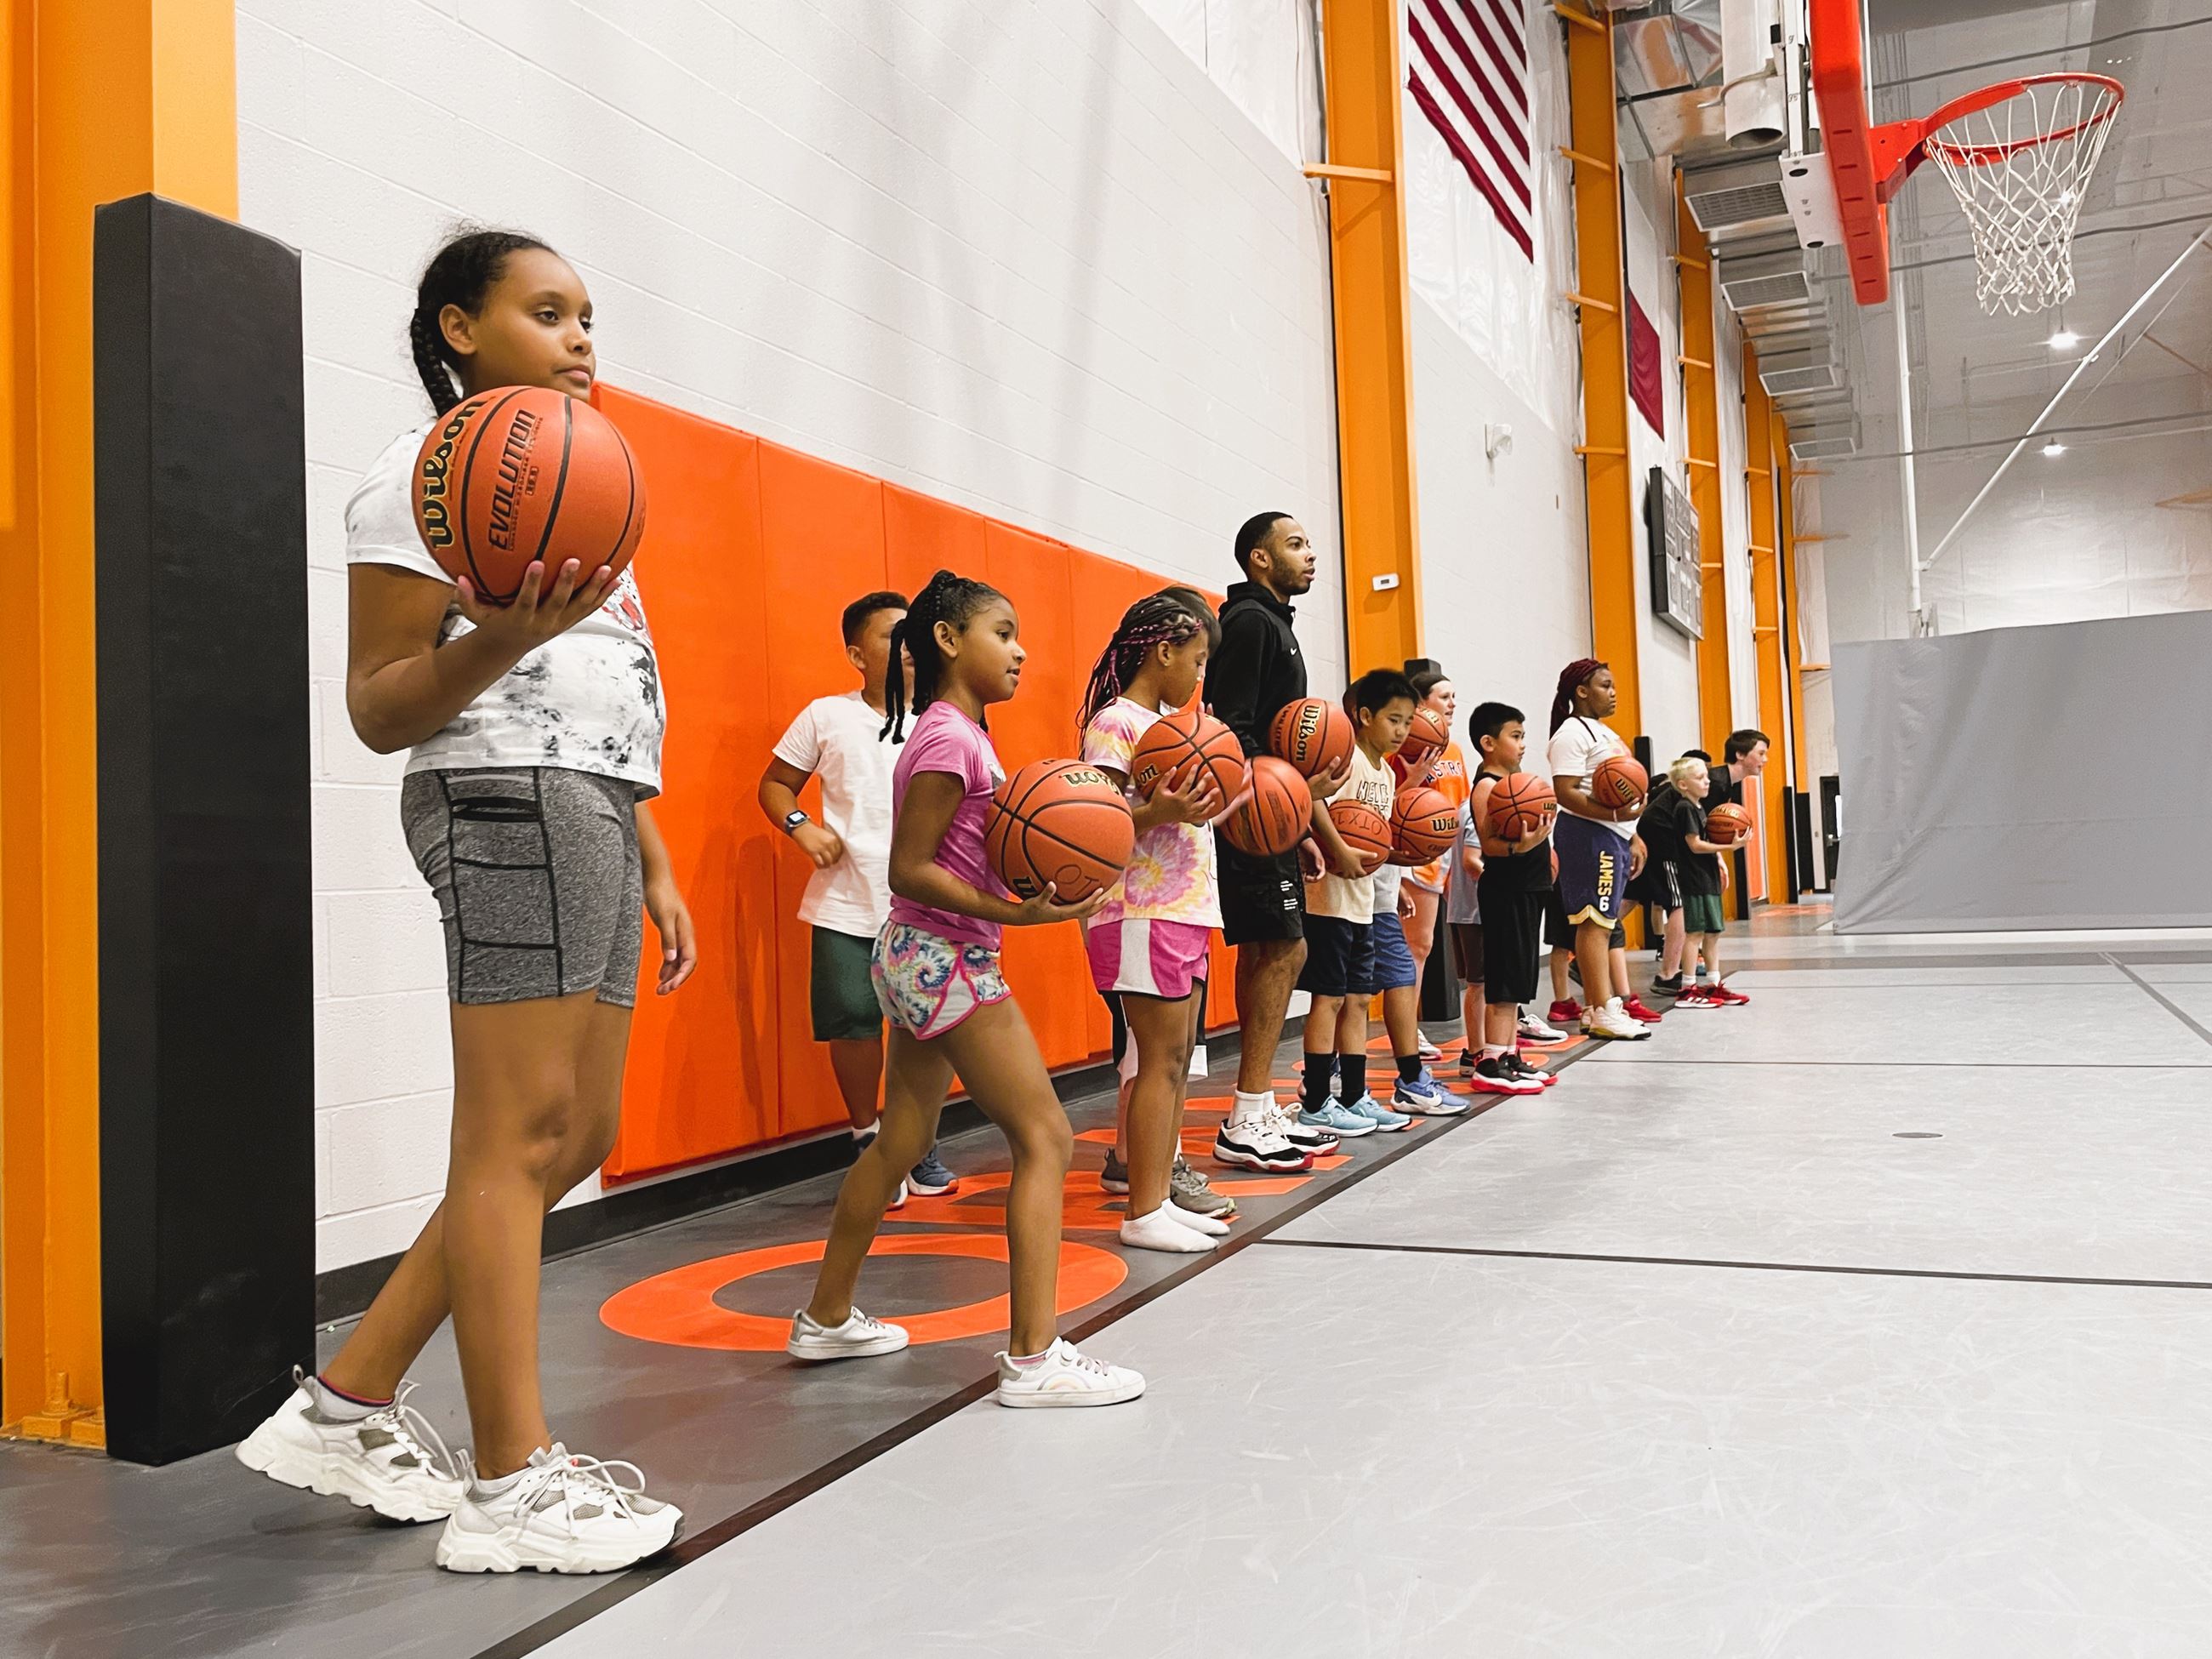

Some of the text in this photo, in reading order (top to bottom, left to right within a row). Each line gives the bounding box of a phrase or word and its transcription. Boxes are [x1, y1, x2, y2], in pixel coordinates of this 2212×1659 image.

[423, 401, 489, 550] Wilson
[488, 409, 536, 551] EVOLUTION
[1296, 704, 1320, 761] Wilson
[1598, 850, 1614, 912] JAMES 6
